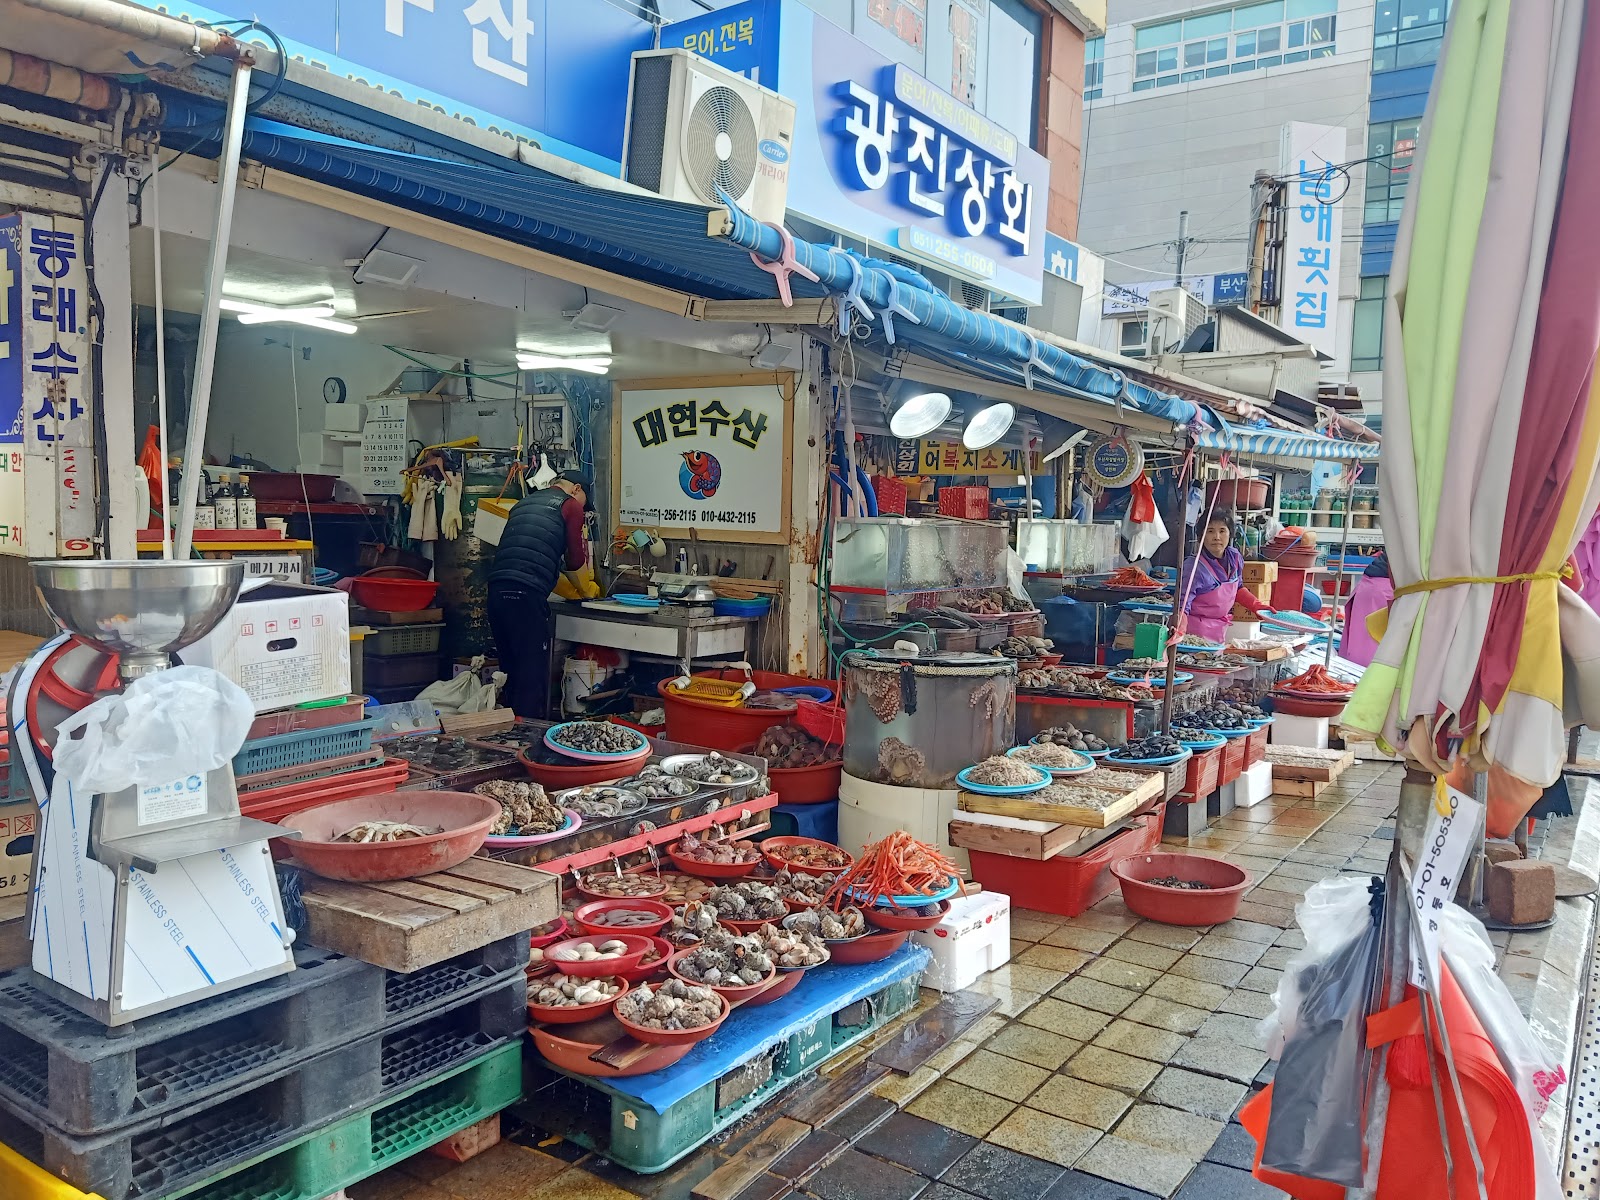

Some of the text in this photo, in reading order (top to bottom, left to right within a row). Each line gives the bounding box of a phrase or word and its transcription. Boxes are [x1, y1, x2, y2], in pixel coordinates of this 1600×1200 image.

[762, 143, 786, 159] Carrier
[845, 78, 1034, 256] 광진상회
[1295, 159, 1334, 329] 남해횟집
[30, 227, 84, 442] 동래수산
[632, 400, 768, 450] 대현수산
[701, 510, 757, 524] 010-4432-2115
[278, 562, 300, 574] 개시
[71, 831, 86, 916] STAINLESS STEEL
[130, 872, 185, 946] STAINLESS STEEL
[222, 853, 272, 923] STAINLESS STEEL
